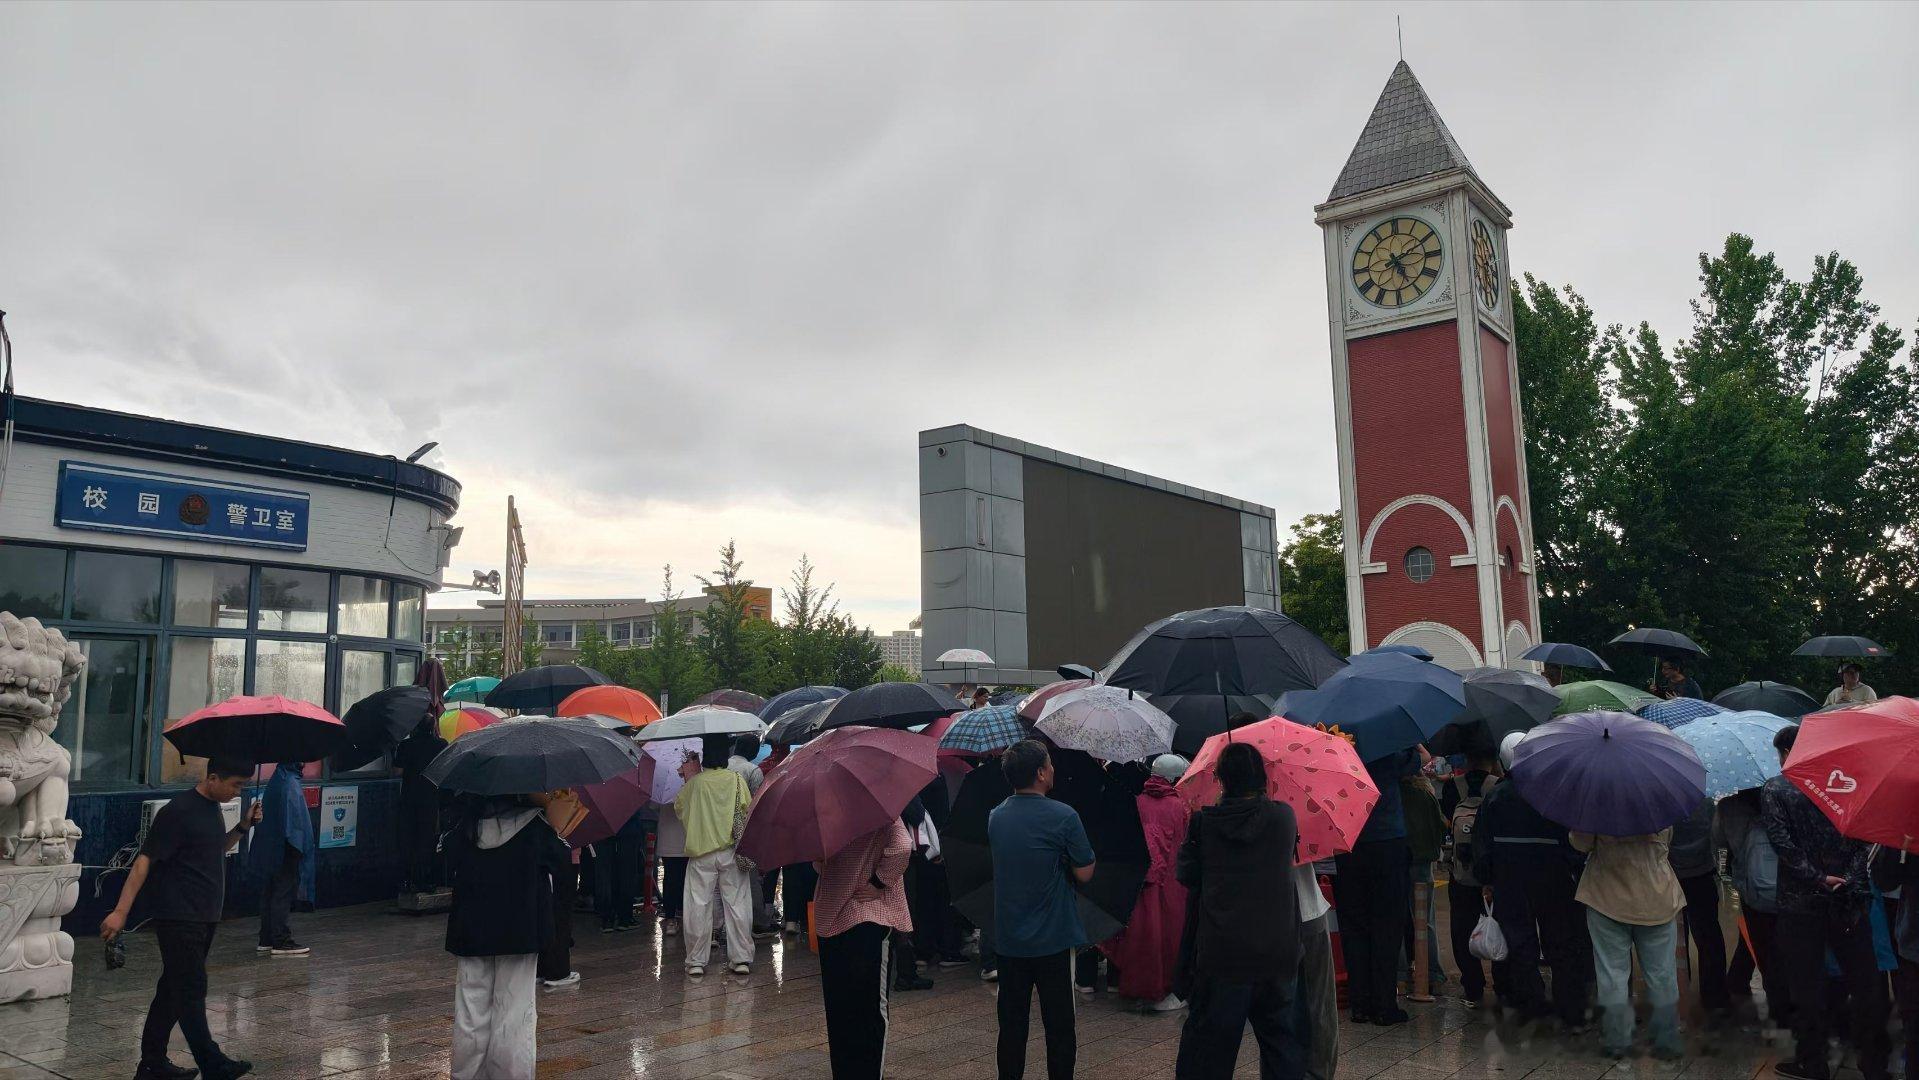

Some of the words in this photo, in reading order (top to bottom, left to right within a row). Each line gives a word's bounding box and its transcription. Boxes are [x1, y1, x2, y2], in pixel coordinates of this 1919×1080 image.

[83, 486, 160, 515] 校园
[226, 502, 295, 531] 警卫室
